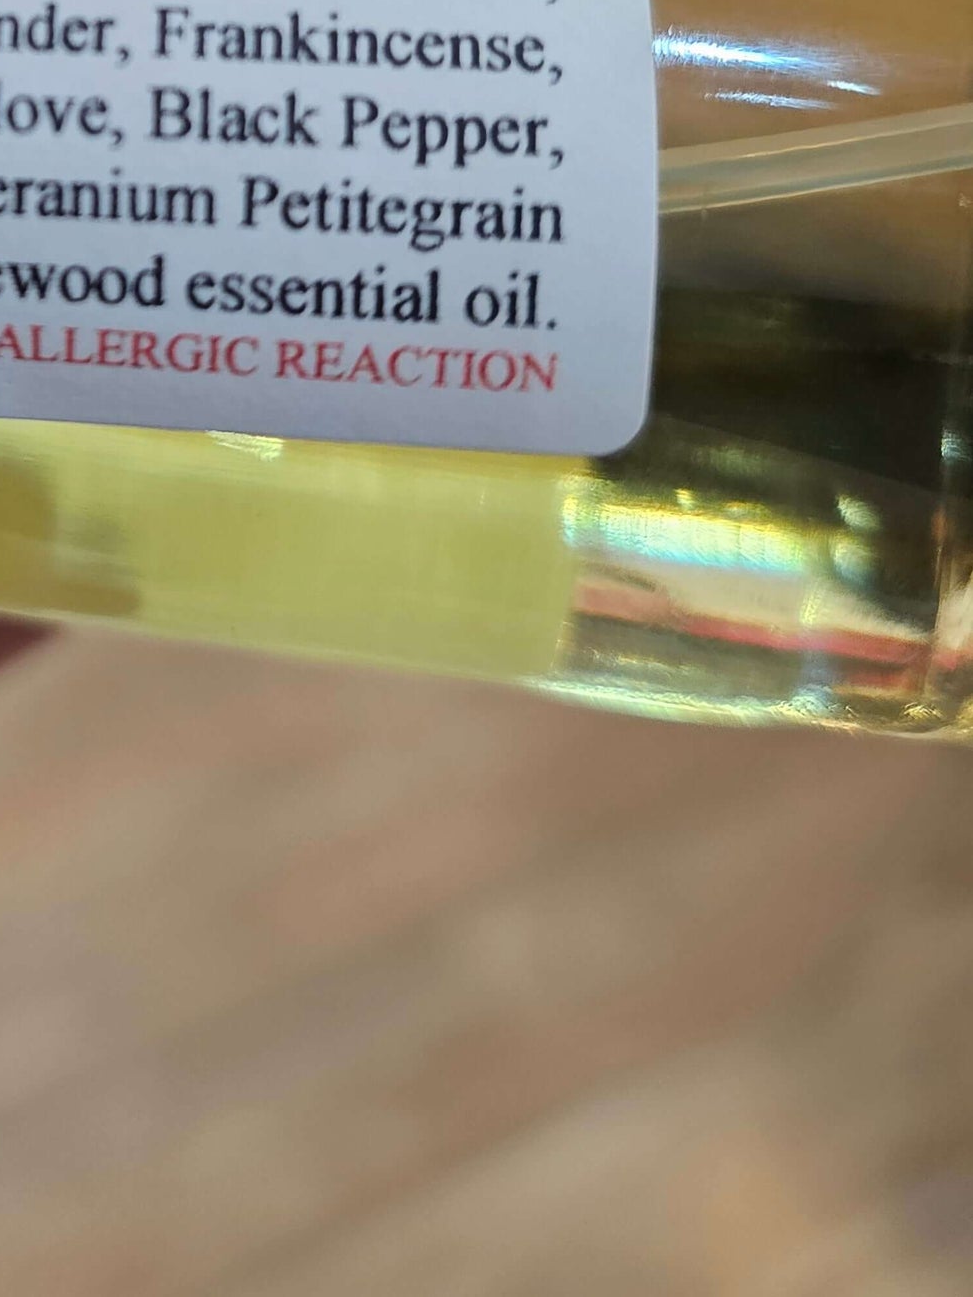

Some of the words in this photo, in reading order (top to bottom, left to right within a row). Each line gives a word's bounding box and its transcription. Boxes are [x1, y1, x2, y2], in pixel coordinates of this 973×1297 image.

[154, 5, 563, 85] Frankincense,
[149, 85, 320, 148] Black
[340, 94, 565, 170] Pepper,
[239, 174, 565, 254] Petitegrain
[184, 264, 441, 325] essential
[463, 271, 557, 331] oil.
[275, 340, 557, 391] REACTION
